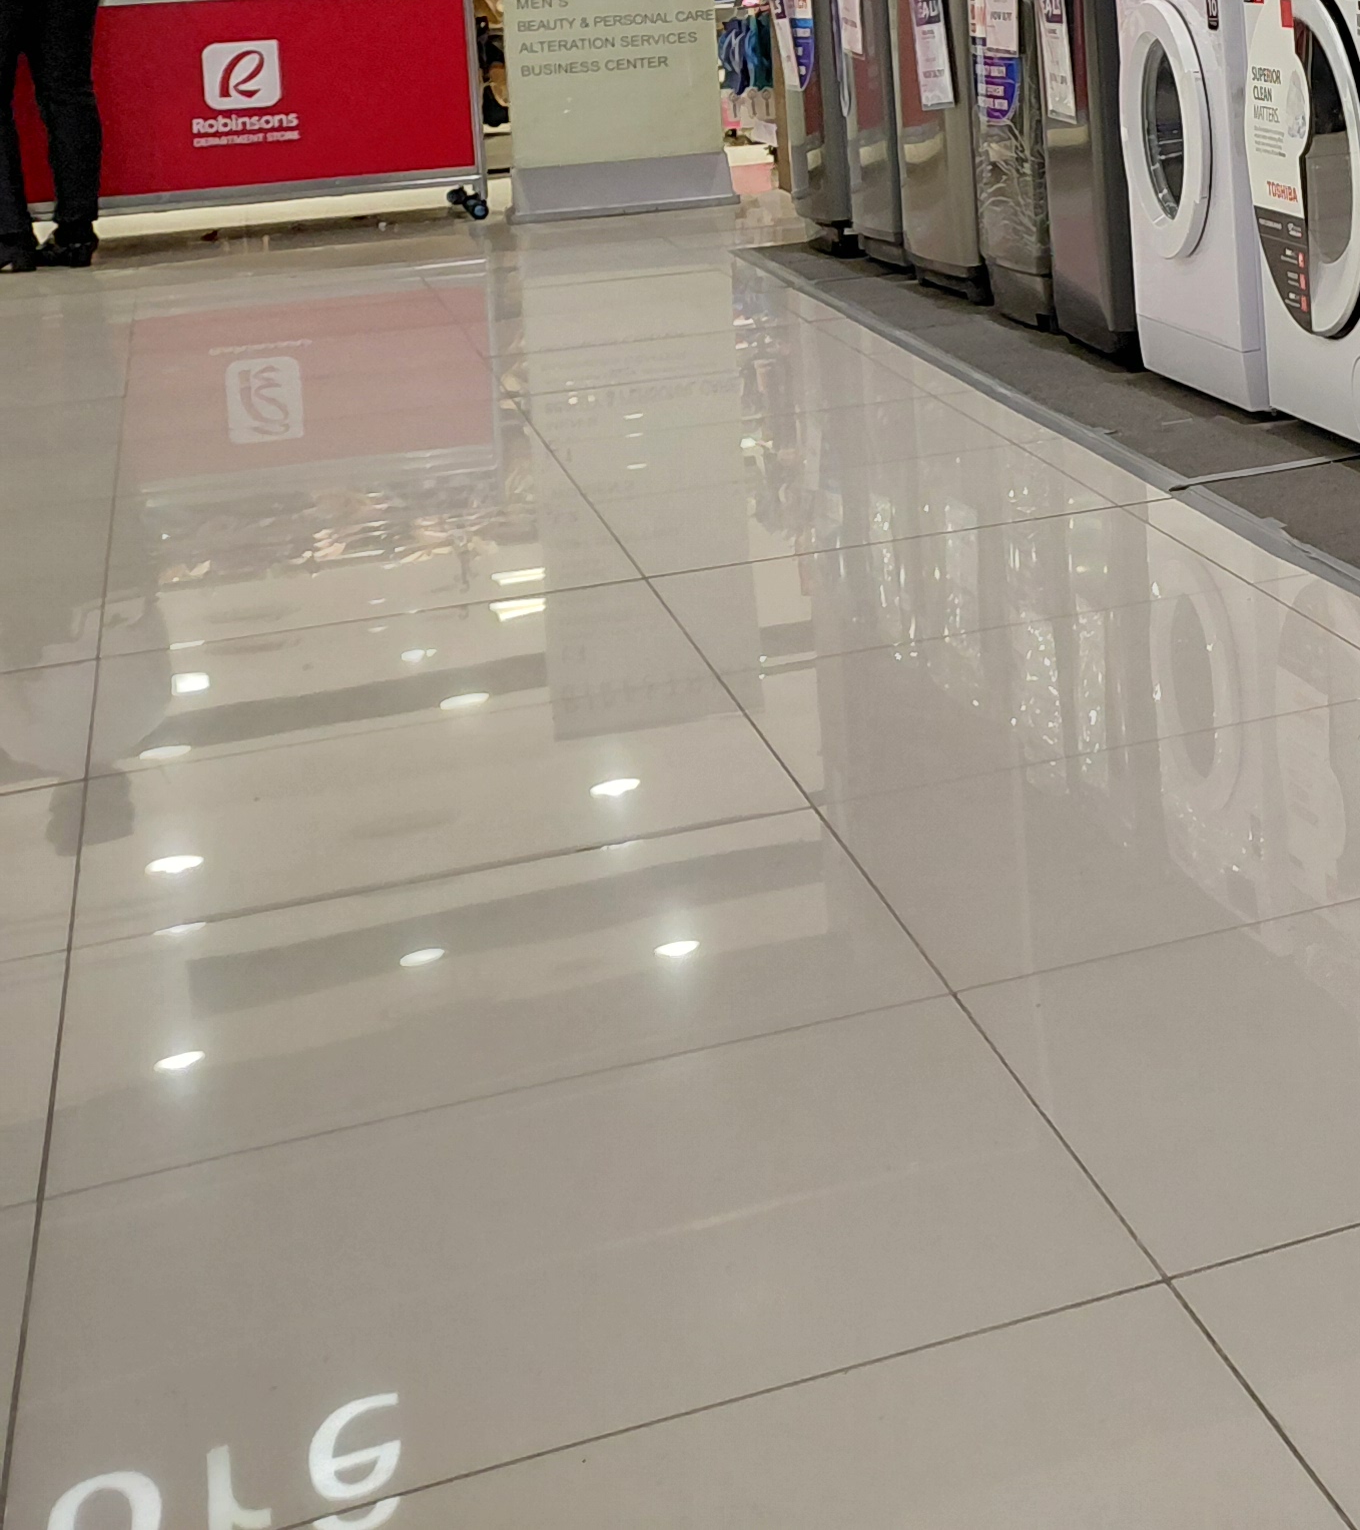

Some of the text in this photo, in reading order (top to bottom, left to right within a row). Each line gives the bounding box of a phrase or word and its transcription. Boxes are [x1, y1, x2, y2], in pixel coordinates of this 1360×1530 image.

[517, 8, 715, 33] BEAUTY & PERSONAL CARE
[518, 31, 698, 55] ALTERATION SERVICES
[520, 55, 670, 78] BUSINESS CENTER
[1251, 64, 1282, 85] SUPERIOR
[1252, 85, 1273, 103] CLEAN
[192, 111, 300, 135] Robinsons
[1266, 180, 1299, 203] TOSHIBA
